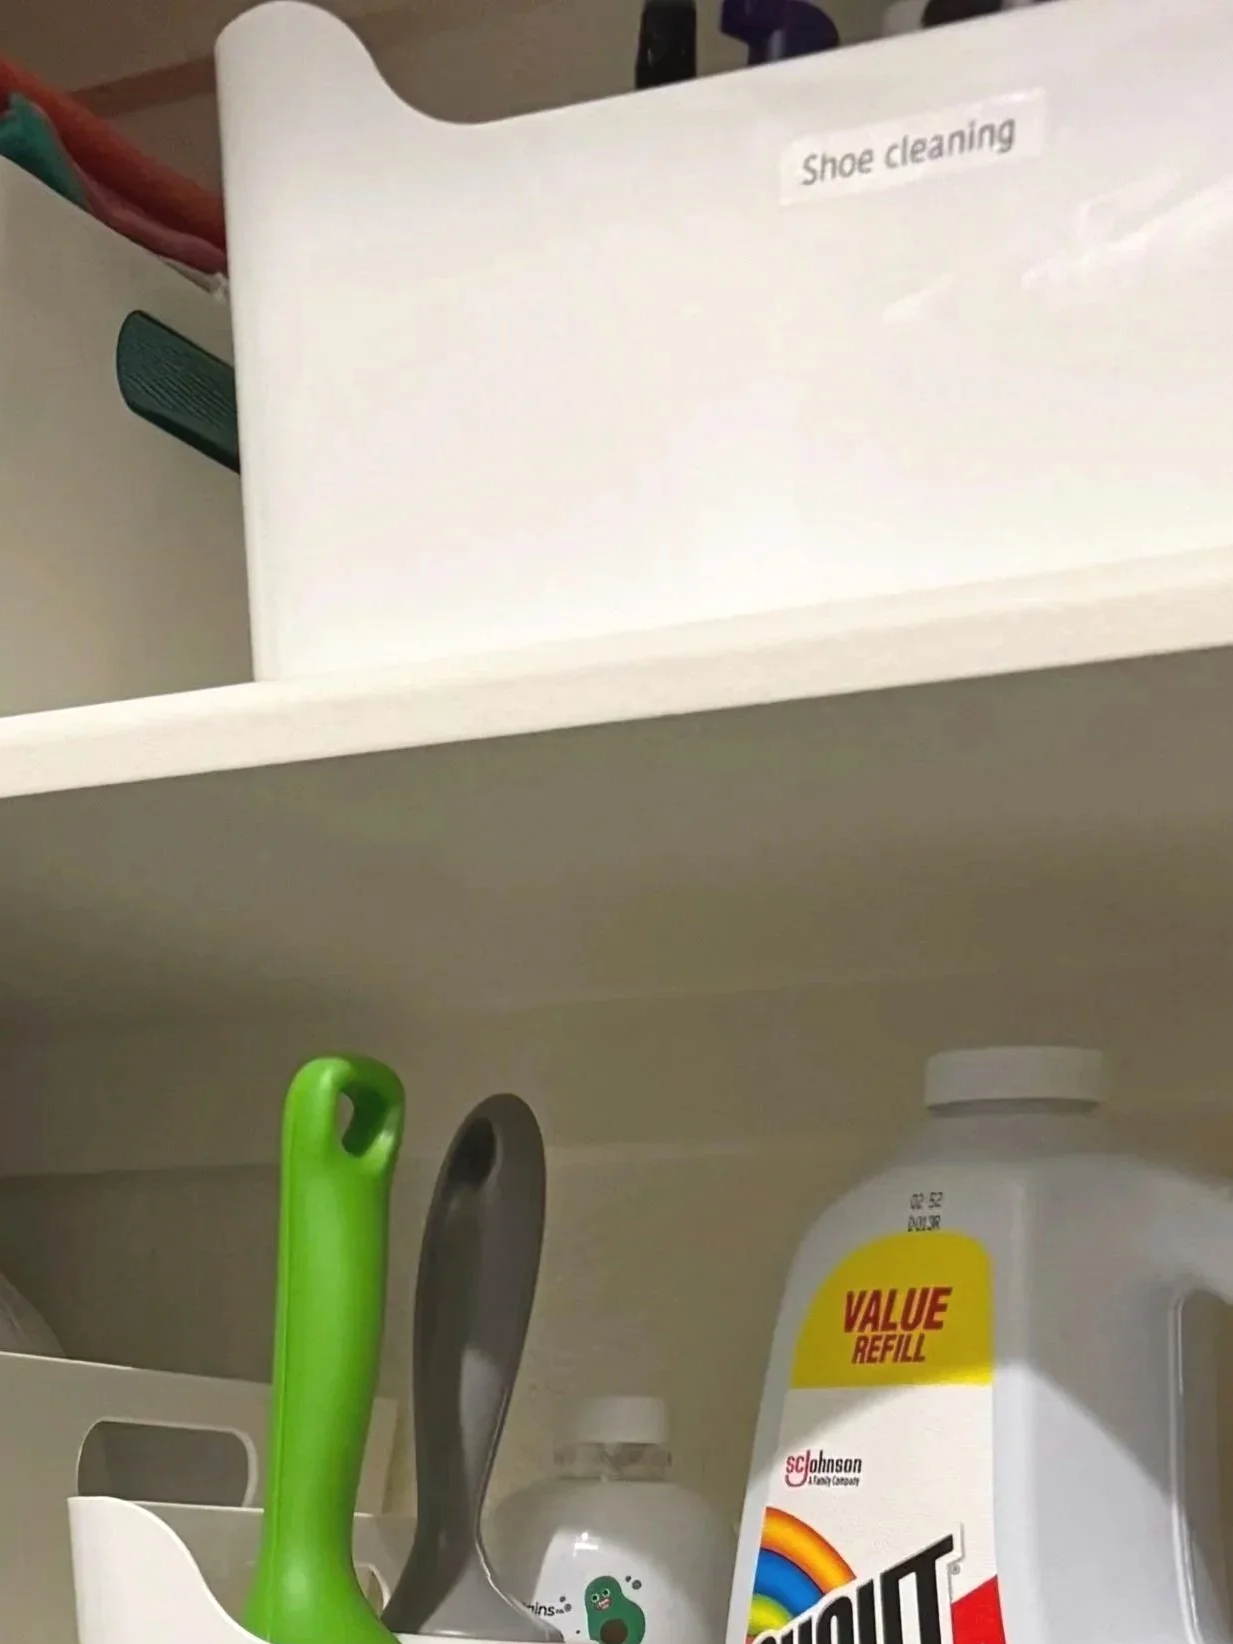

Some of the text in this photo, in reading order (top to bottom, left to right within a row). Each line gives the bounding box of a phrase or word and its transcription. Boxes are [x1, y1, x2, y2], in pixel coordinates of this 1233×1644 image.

[801, 117, 1016, 186] Shoe cleaning
[843, 1286, 953, 1333] VALUE
[851, 1333, 926, 1364] REFILL
